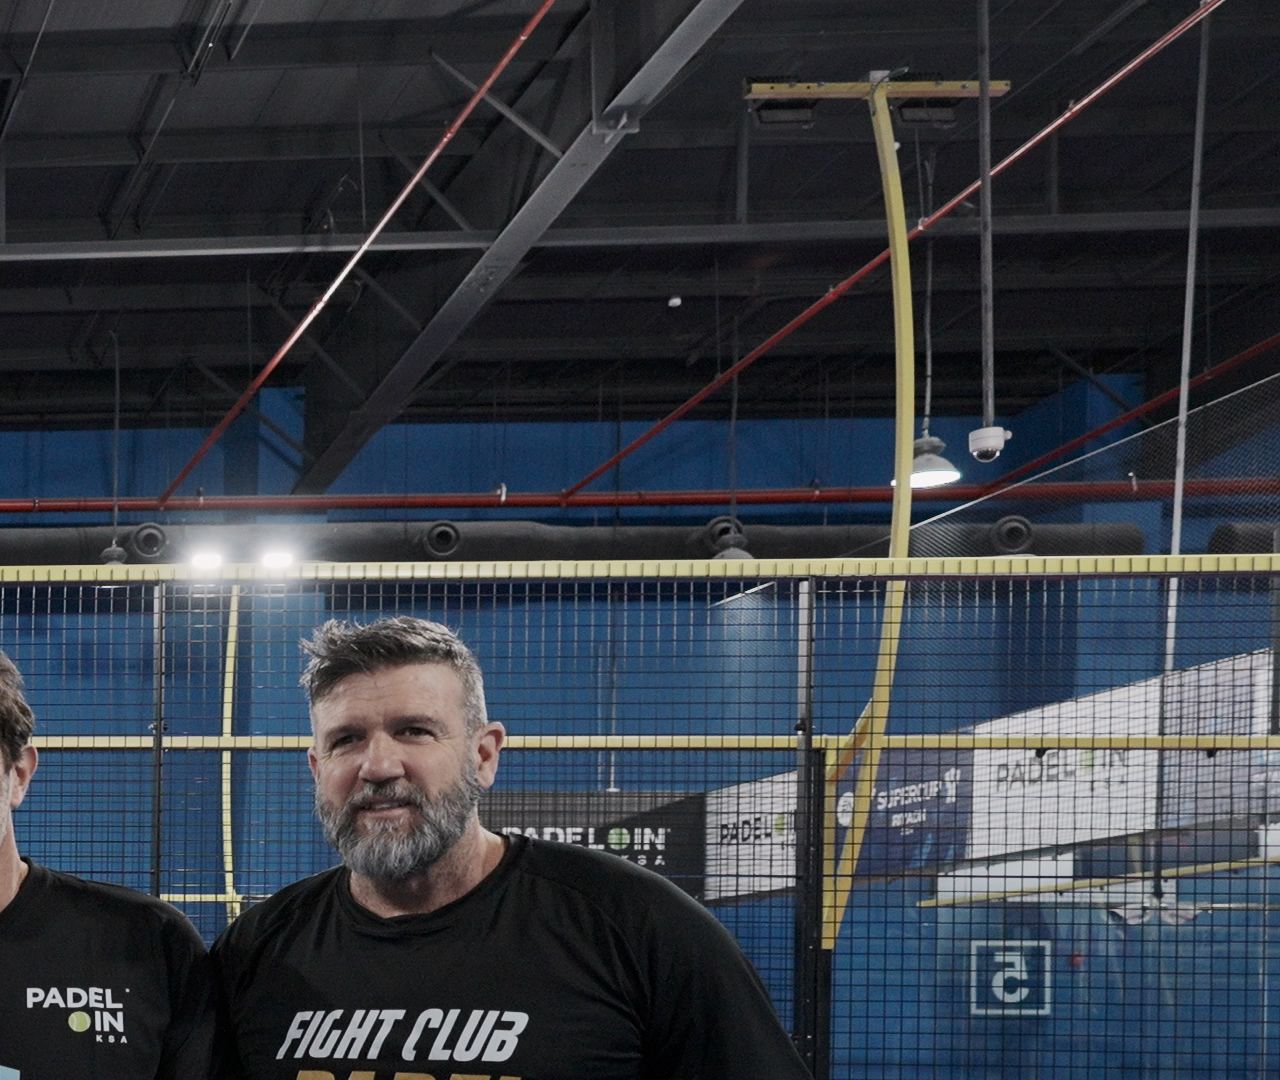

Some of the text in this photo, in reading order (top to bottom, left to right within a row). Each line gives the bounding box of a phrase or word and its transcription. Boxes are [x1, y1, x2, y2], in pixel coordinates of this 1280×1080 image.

[25, 987, 124, 1009] PADEL
[94, 1010, 125, 1033] IN
[275, 1007, 530, 1063] FIGHT CLUB
